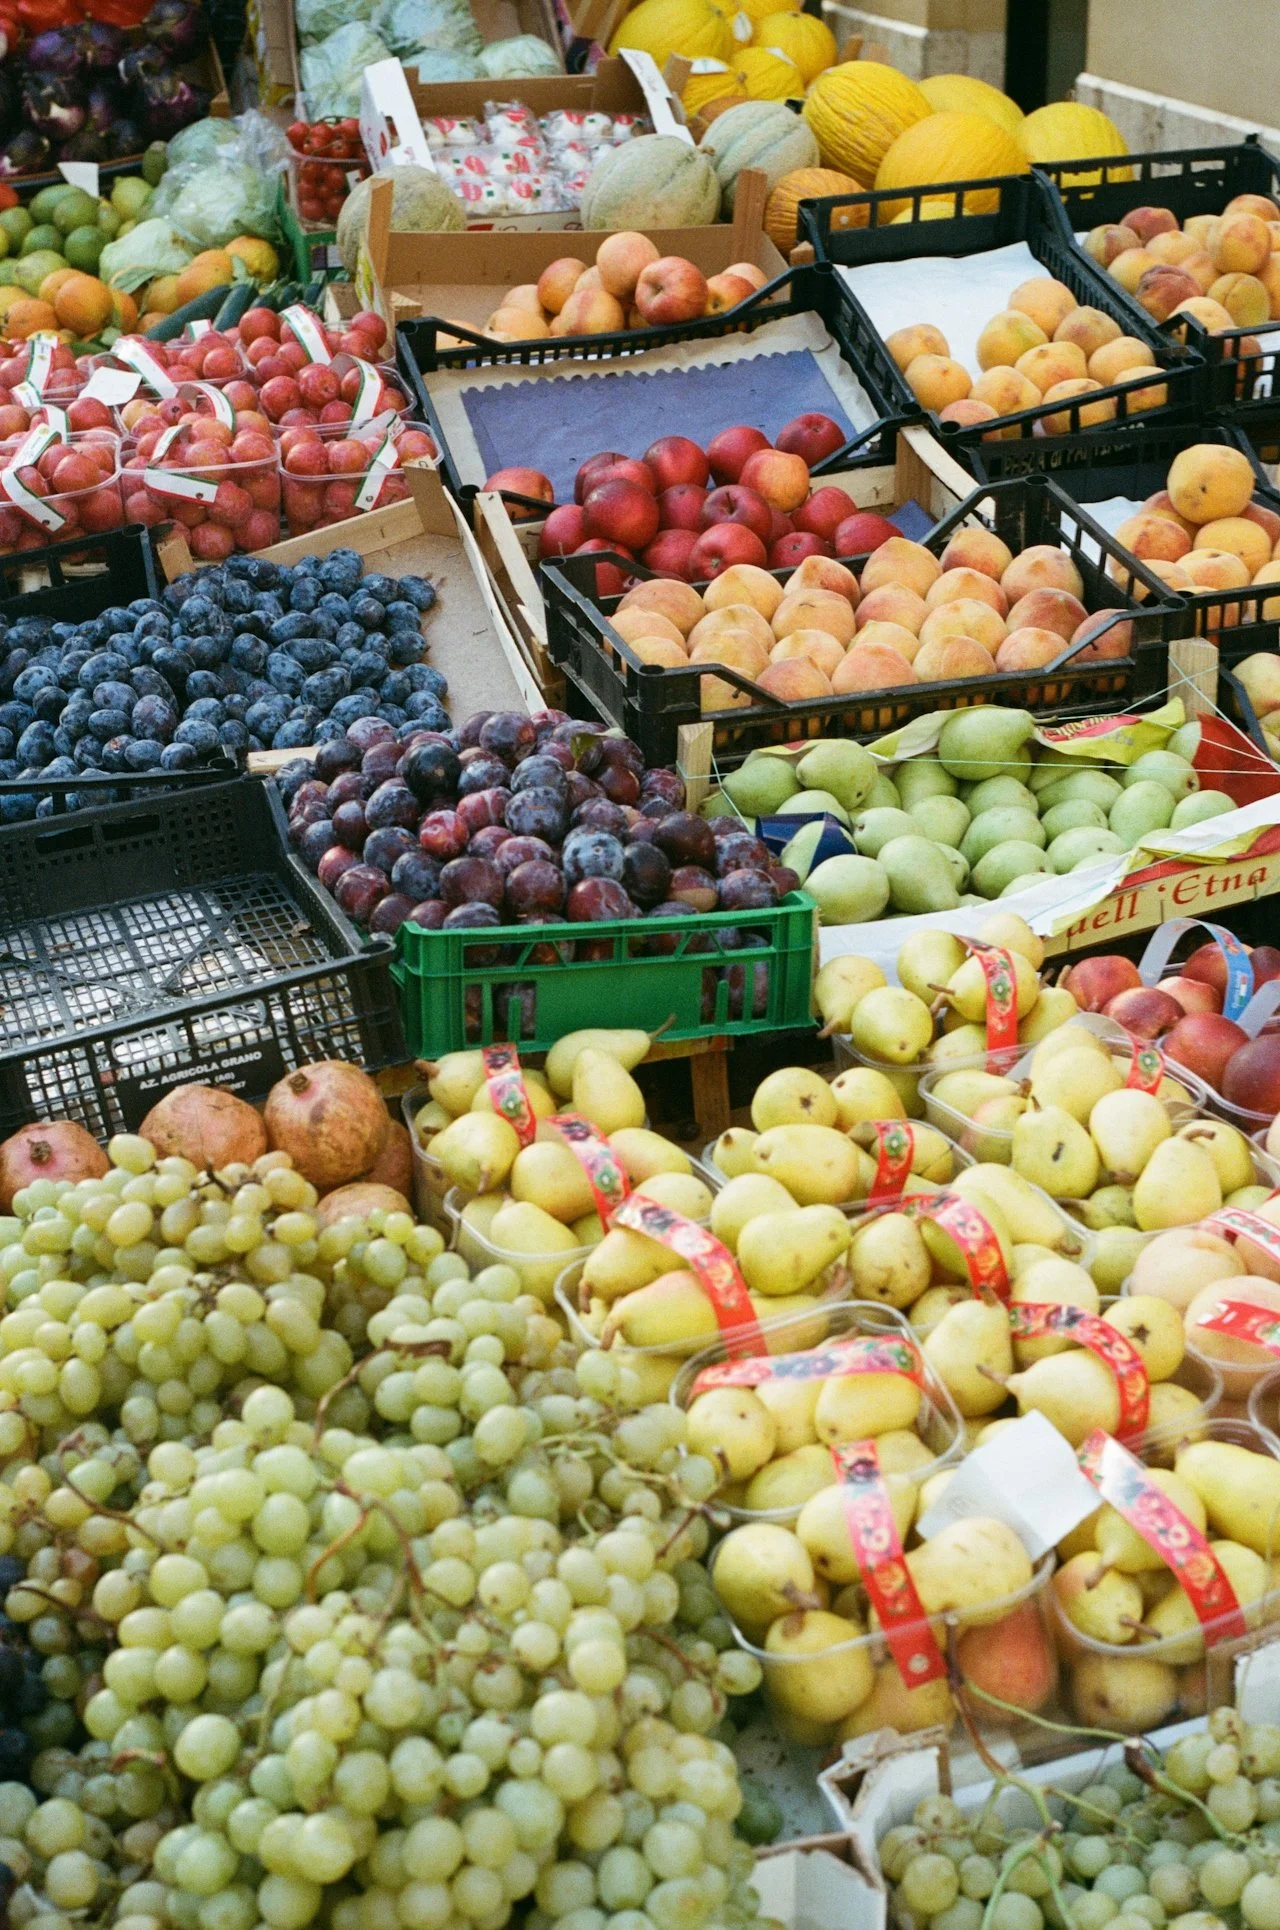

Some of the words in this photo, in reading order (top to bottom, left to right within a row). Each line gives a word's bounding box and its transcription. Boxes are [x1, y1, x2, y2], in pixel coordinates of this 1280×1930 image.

[139, 1078, 159, 1090] AZ.
[161, 1062, 220, 1085] AGRICOLA
[221, 1051, 263, 1068] GRANO
